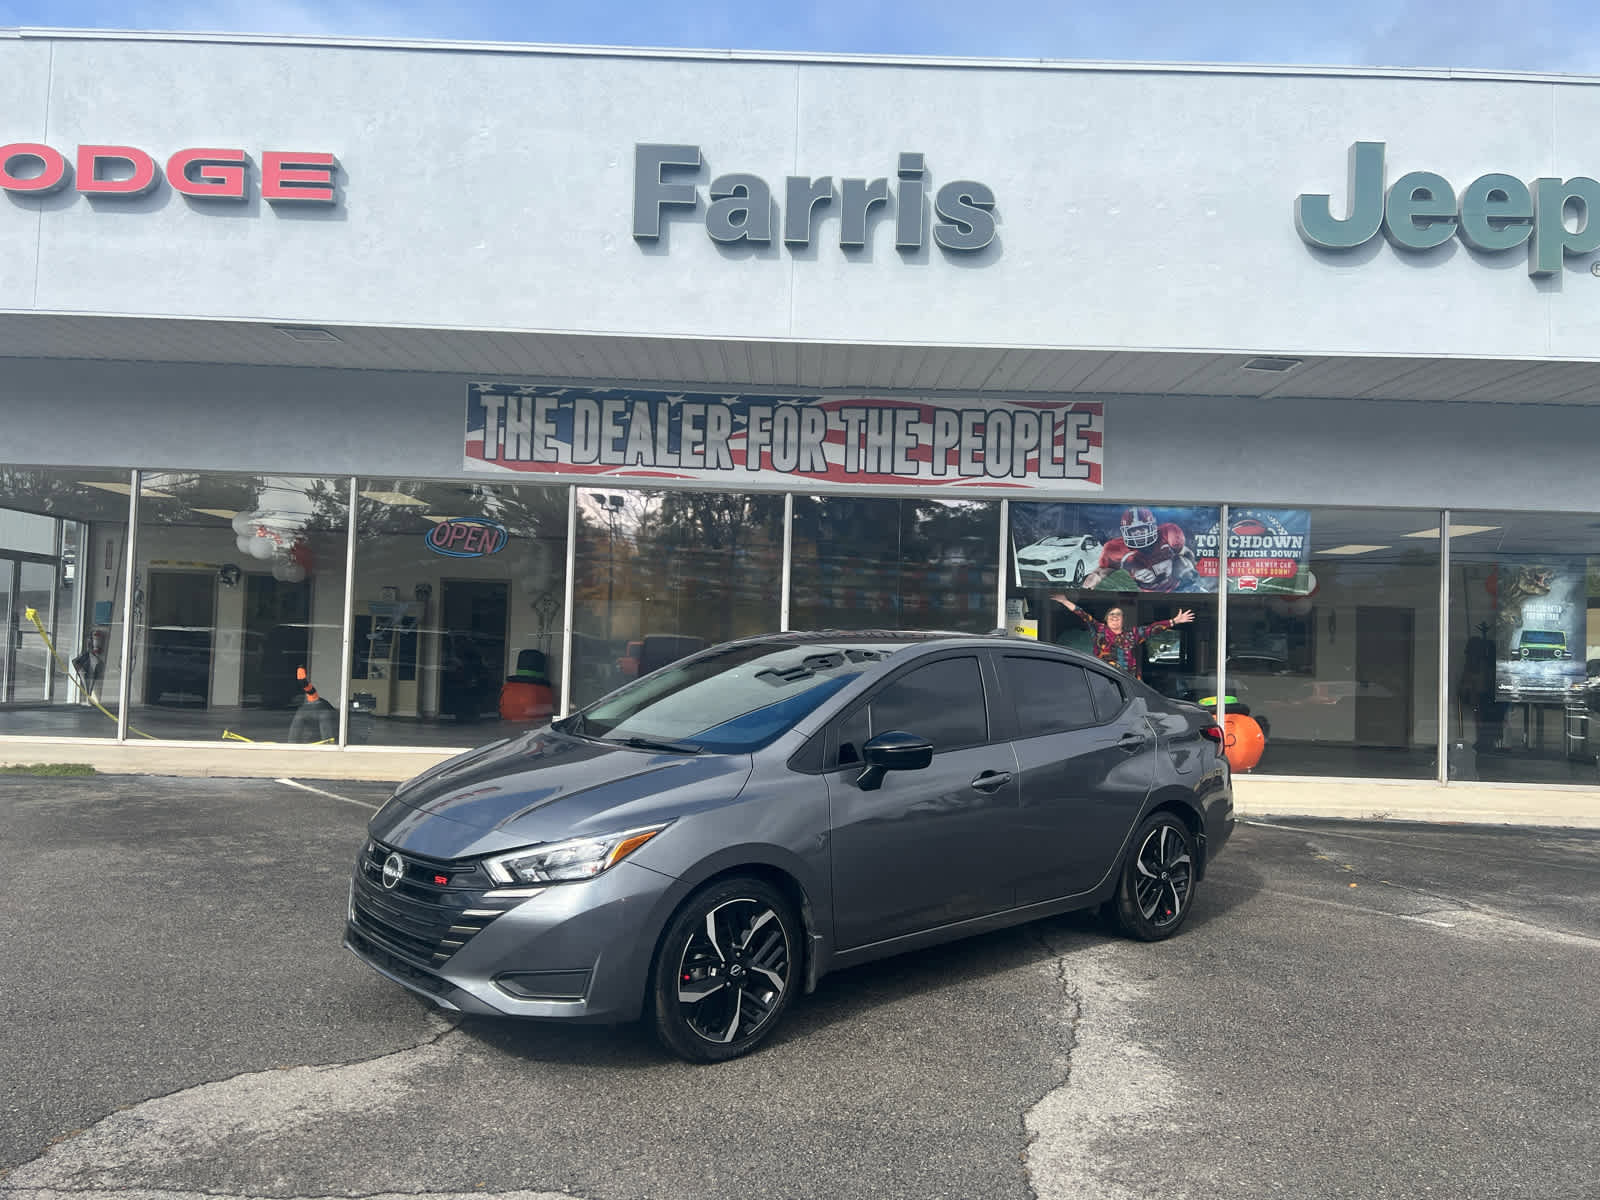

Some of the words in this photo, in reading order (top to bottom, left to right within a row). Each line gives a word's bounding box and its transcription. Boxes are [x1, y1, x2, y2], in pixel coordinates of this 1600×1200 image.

[633, 142, 997, 252] Farris
[1296, 141, 1600, 275] Jeep
[480, 395, 559, 463] THE
[571, 397, 735, 471] DEALER
[745, 403, 829, 474] FOR
[839, 406, 921, 475] THE
[931, 408, 1092, 479] PEOPLE
[432, 521, 499, 554] OPEN
[1194, 534, 1304, 549] TOCHDOWN
[1196, 549, 1215, 557] FOR
[1239, 549, 1269, 558] MUCH
